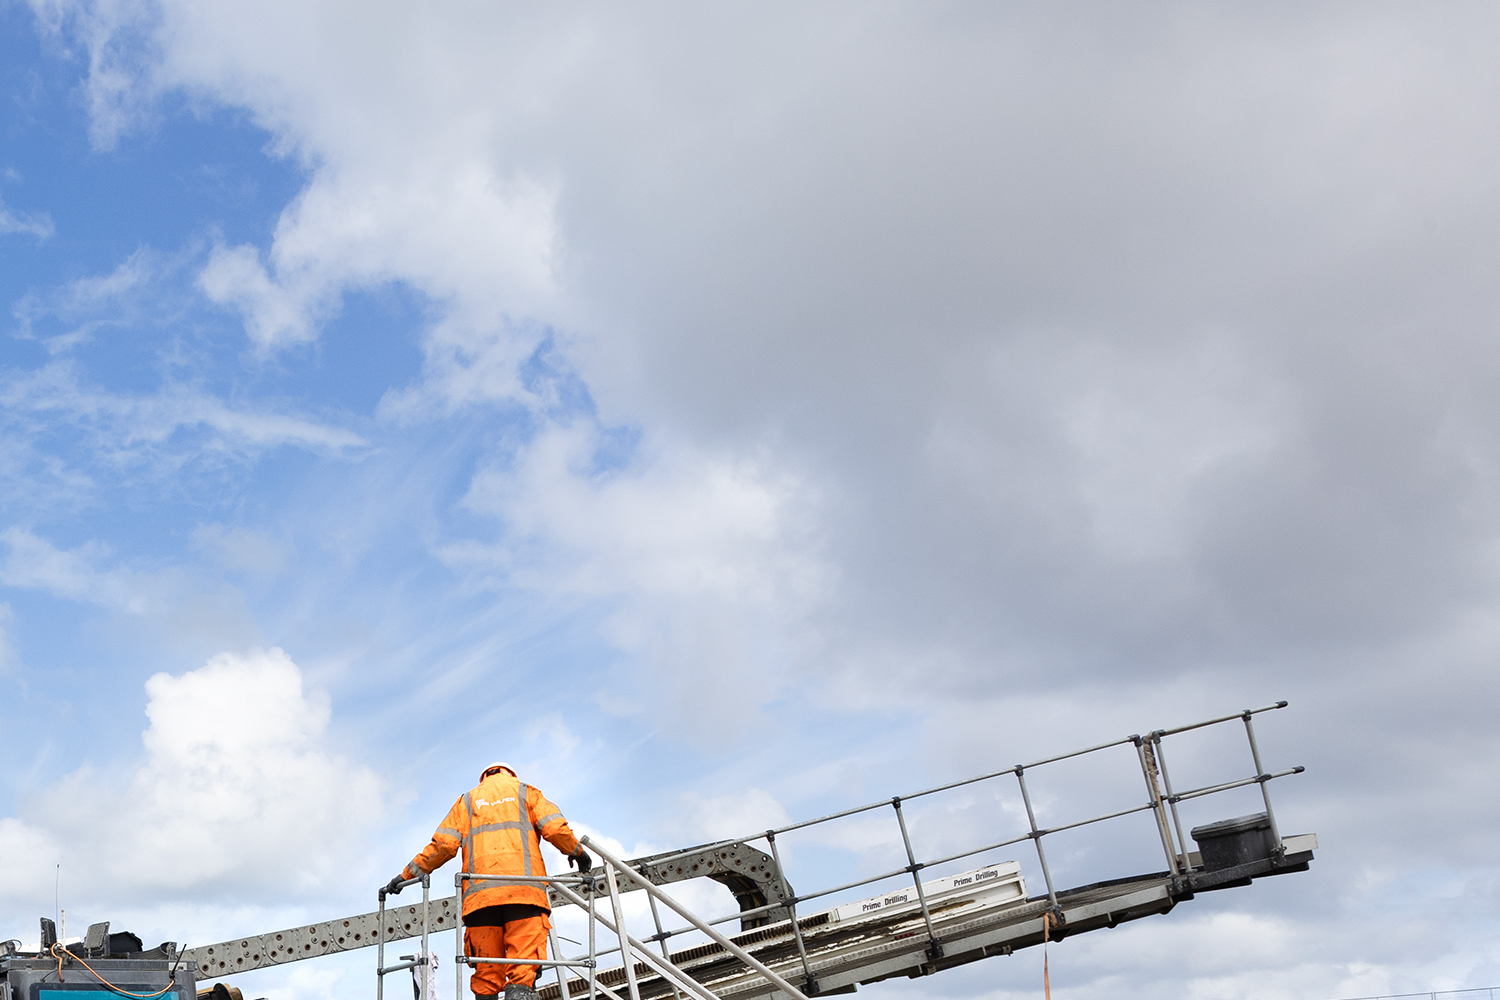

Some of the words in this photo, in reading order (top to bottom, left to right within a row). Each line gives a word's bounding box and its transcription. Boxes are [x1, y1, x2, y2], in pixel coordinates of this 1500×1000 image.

[954, 876, 972, 887] Prime
[975, 869, 999, 881] Drilling
[862, 902, 881, 912] Prime
[884, 894, 908, 906] Drilling
